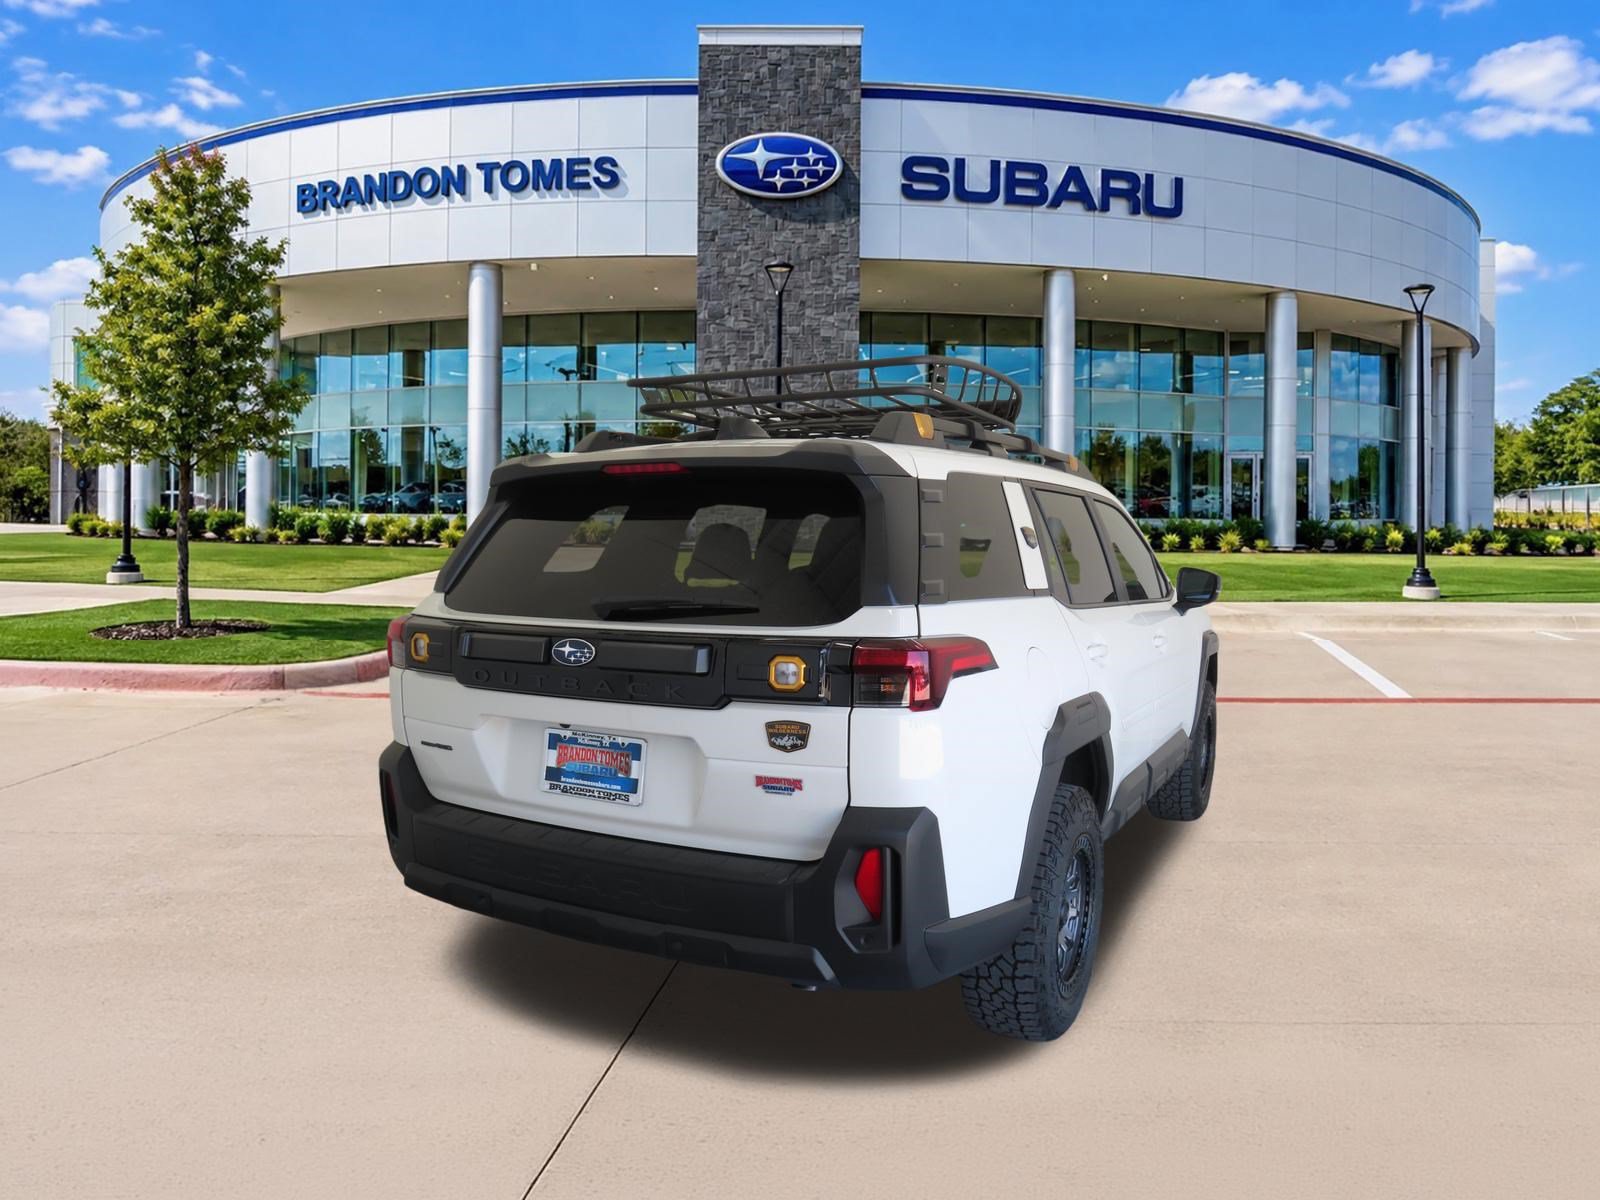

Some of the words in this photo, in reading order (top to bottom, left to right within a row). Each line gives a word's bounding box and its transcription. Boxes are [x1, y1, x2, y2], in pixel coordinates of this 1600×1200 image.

[297, 164, 467, 213] BRANDON
[476, 156, 621, 194] TOMES
[901, 155, 1184, 218] SUBARU
[473, 668, 686, 700] OUTBACK
[557, 743, 597, 768] BRANDON
[597, 749, 632, 777] TOMES
[565, 762, 619, 777] SUBARU
[549, 782, 594, 795] BRANDON
[595, 789, 630, 802] TOMES
